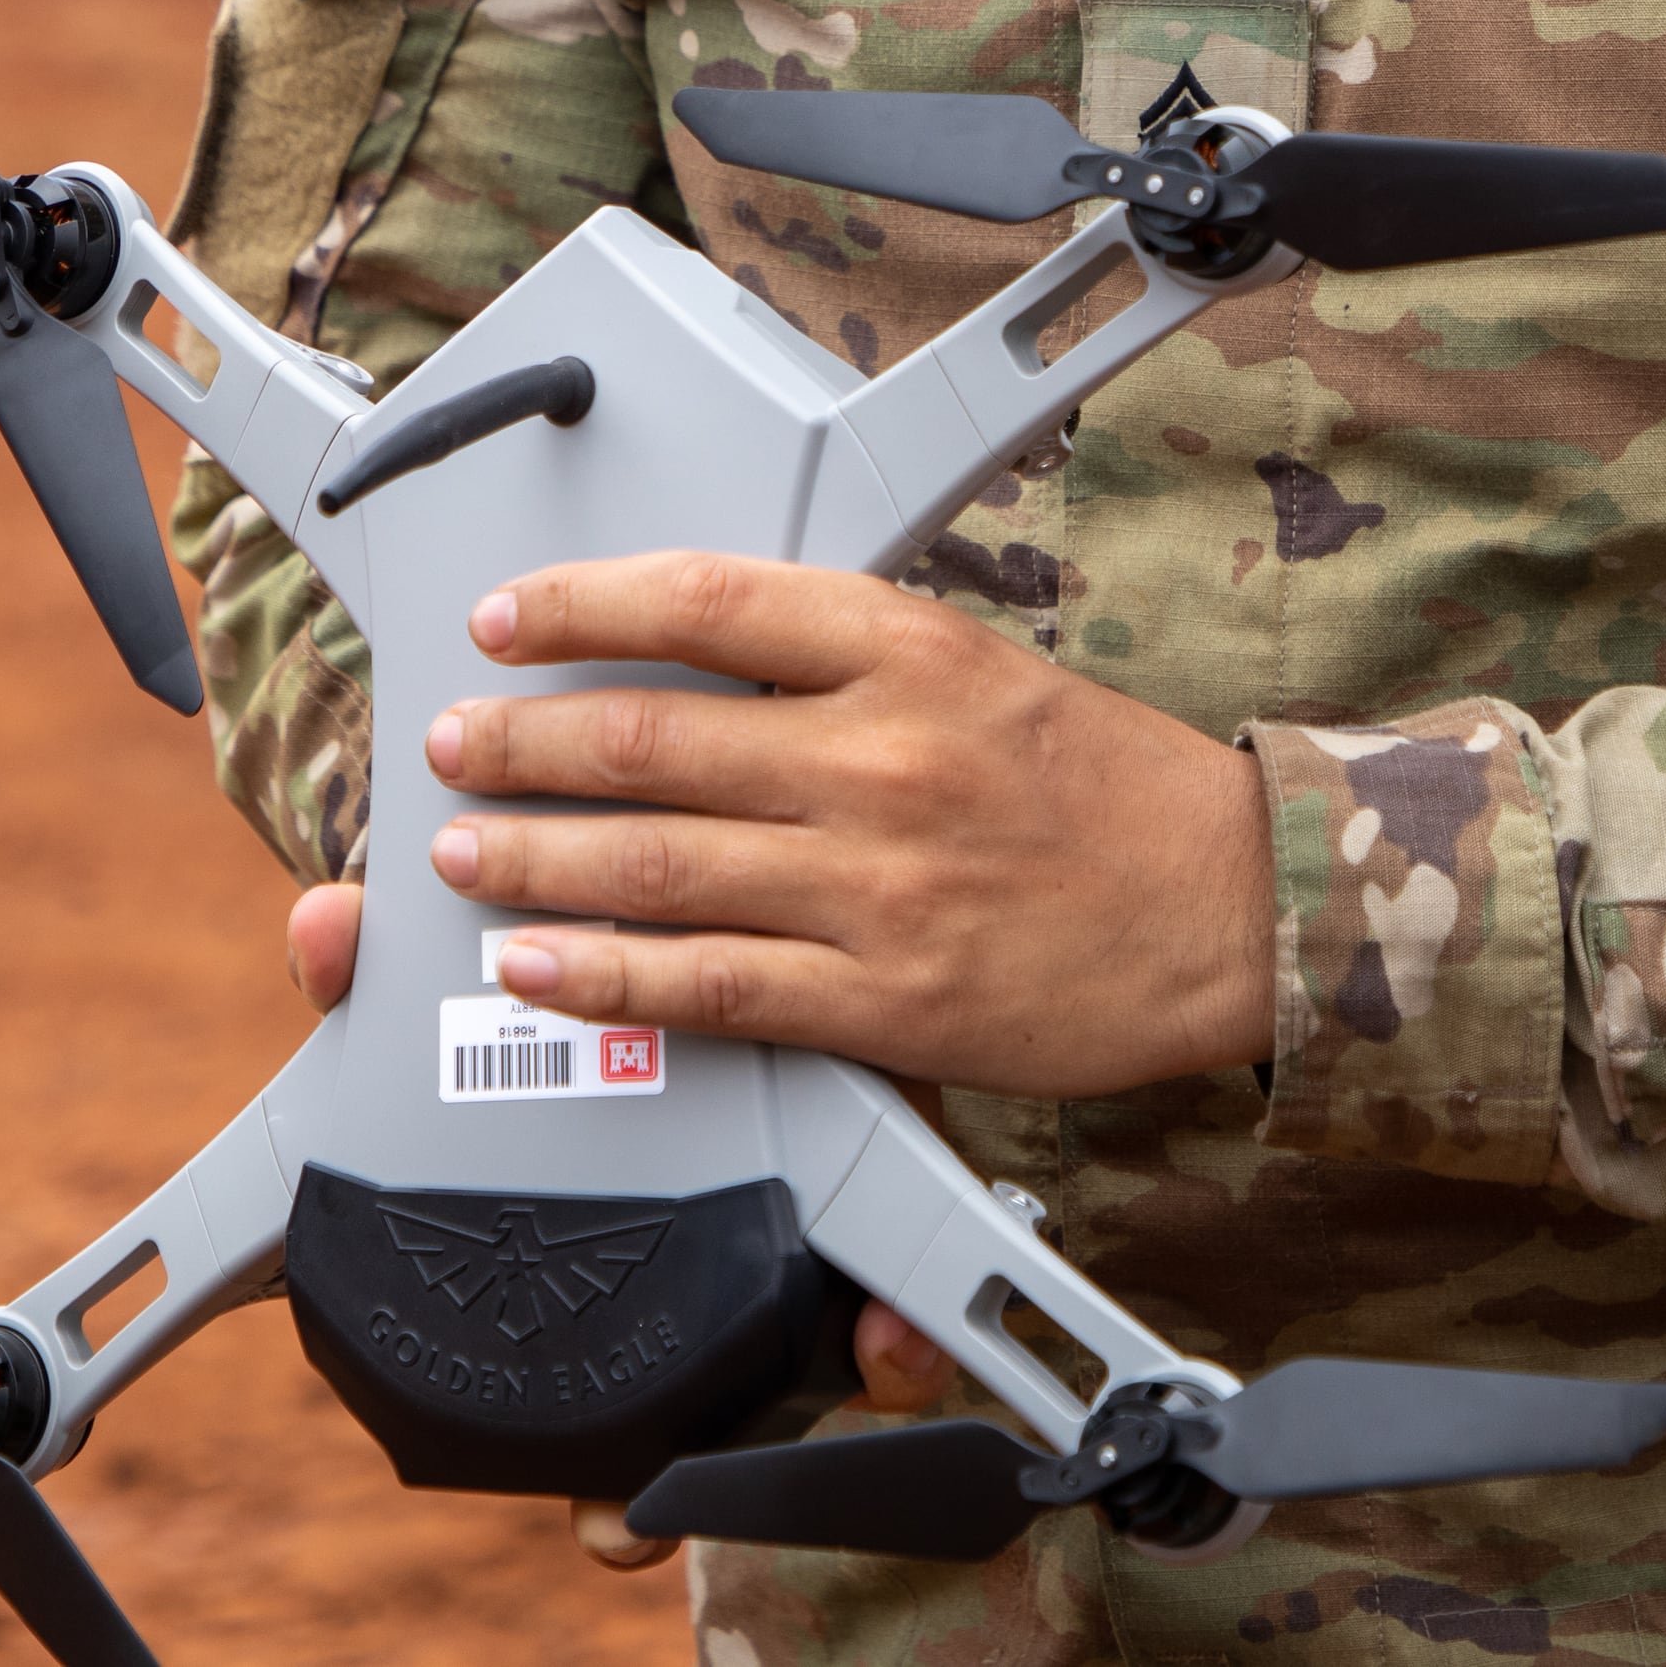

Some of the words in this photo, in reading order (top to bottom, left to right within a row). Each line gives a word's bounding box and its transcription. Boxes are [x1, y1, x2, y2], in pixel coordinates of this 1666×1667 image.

[498, 1025, 537, 1039] R6818
[368, 1308, 530, 1407] GOLDEN
[551, 1316, 681, 1405] EAGLE
